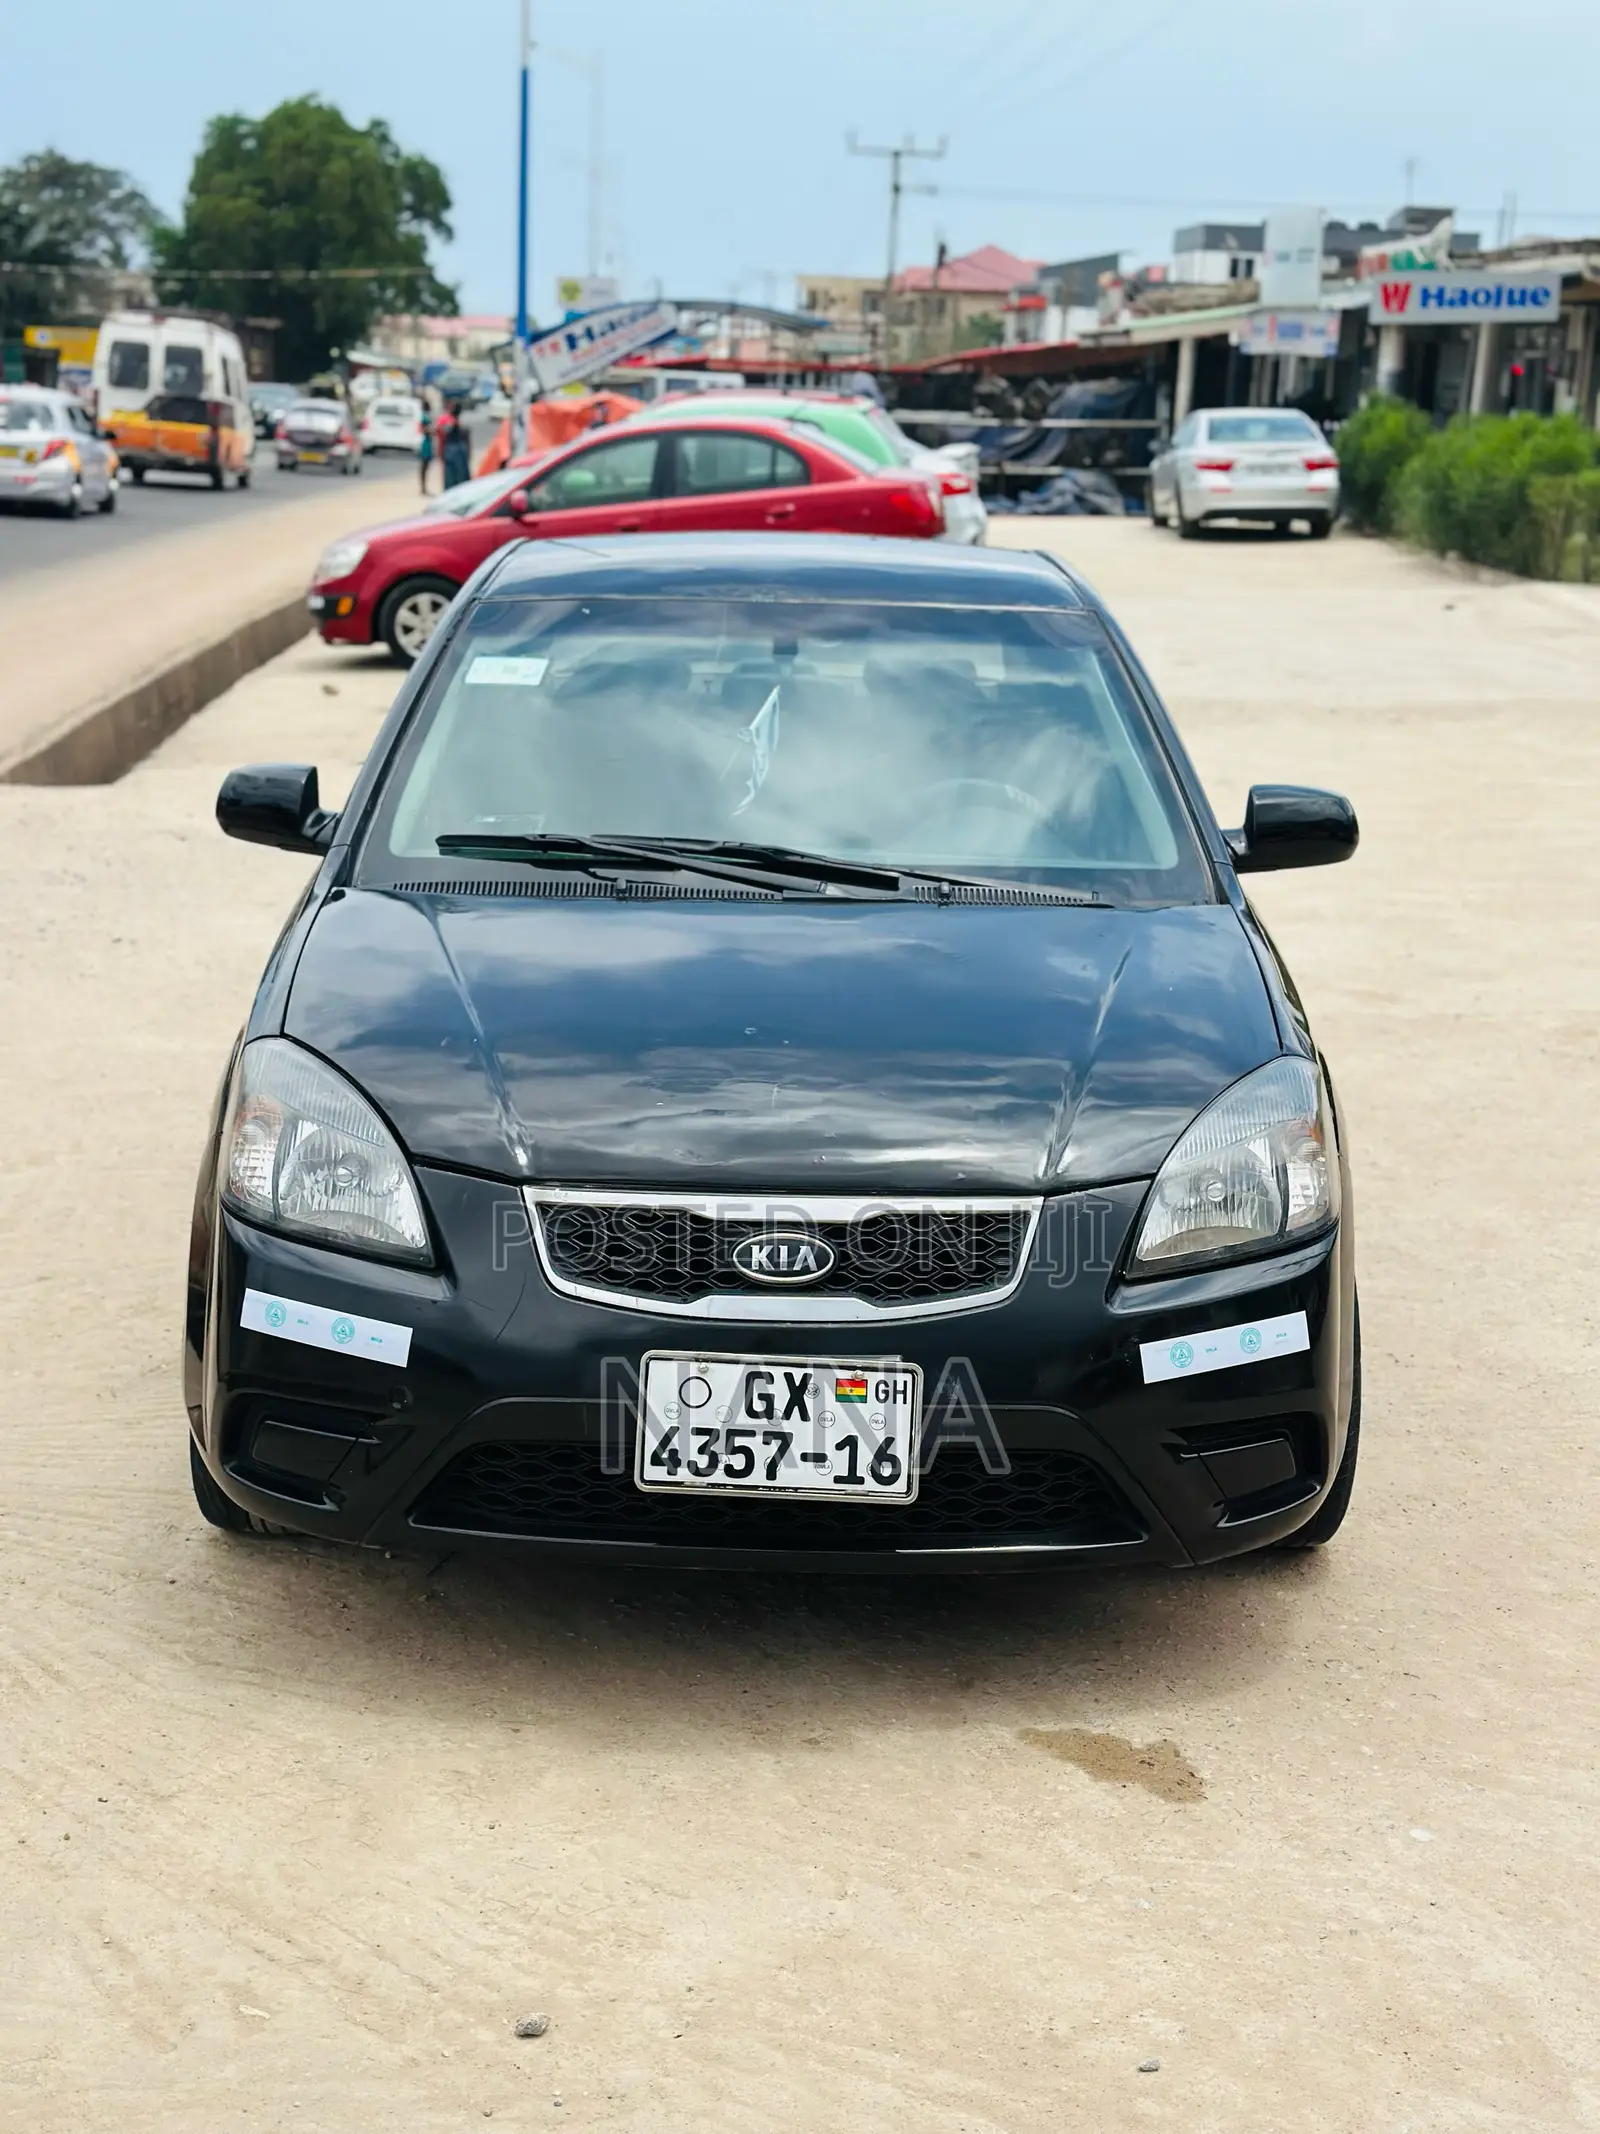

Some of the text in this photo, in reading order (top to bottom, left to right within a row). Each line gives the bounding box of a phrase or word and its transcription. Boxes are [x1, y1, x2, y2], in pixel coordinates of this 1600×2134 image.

[1420, 283, 1551, 309] Haojue
[750, 1244, 819, 1272] KIA
[744, 1370, 908, 1422] GX GH
[650, 1425, 902, 1486] 4357-16
